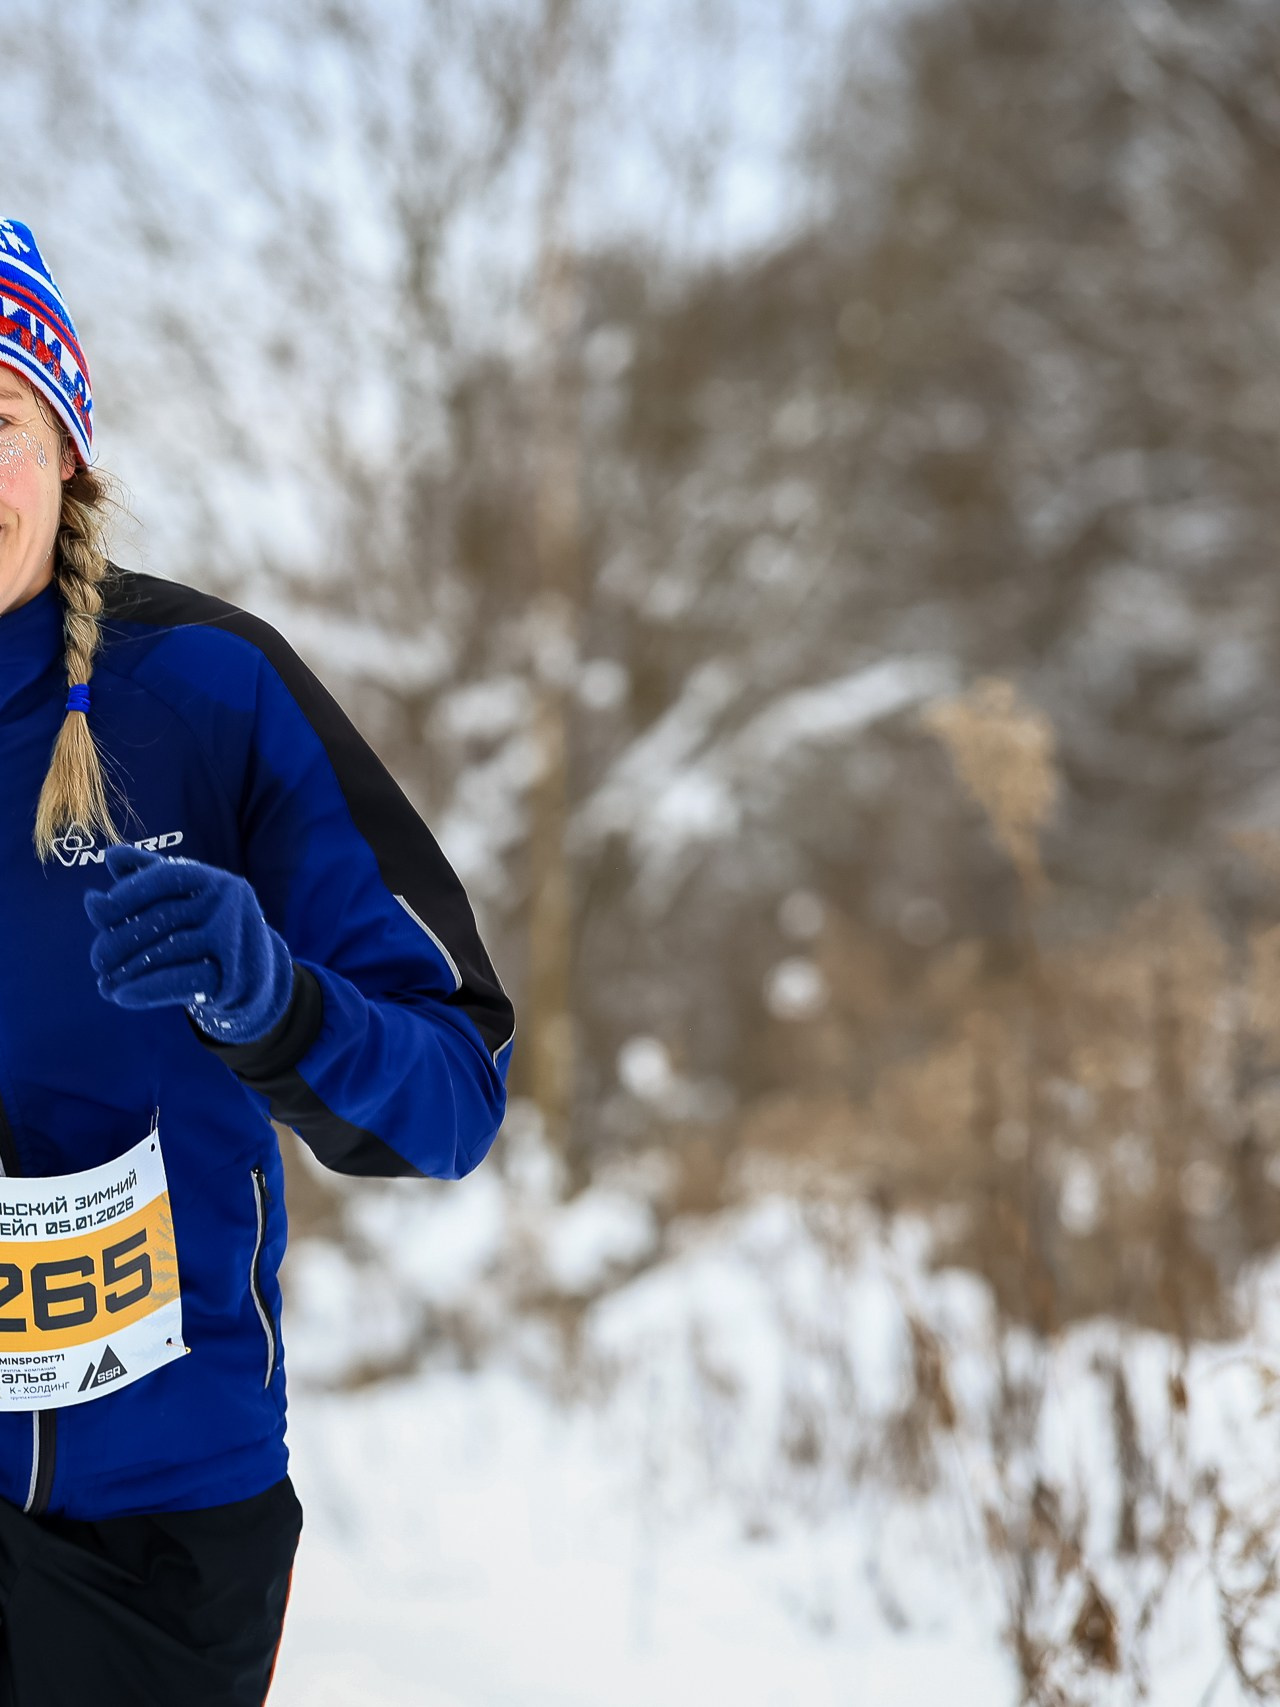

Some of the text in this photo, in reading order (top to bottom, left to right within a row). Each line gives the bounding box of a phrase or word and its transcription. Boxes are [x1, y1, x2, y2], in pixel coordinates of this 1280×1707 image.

[79, 831, 184, 866] NRD
[75, 1168, 138, 1211] ЗИМНИЙ
[45, 1195, 135, 1236] 05.01.2026
[1, 1371, 57, 1384] ЭЛЬФ
[97, 1365, 121, 1384] SSR
